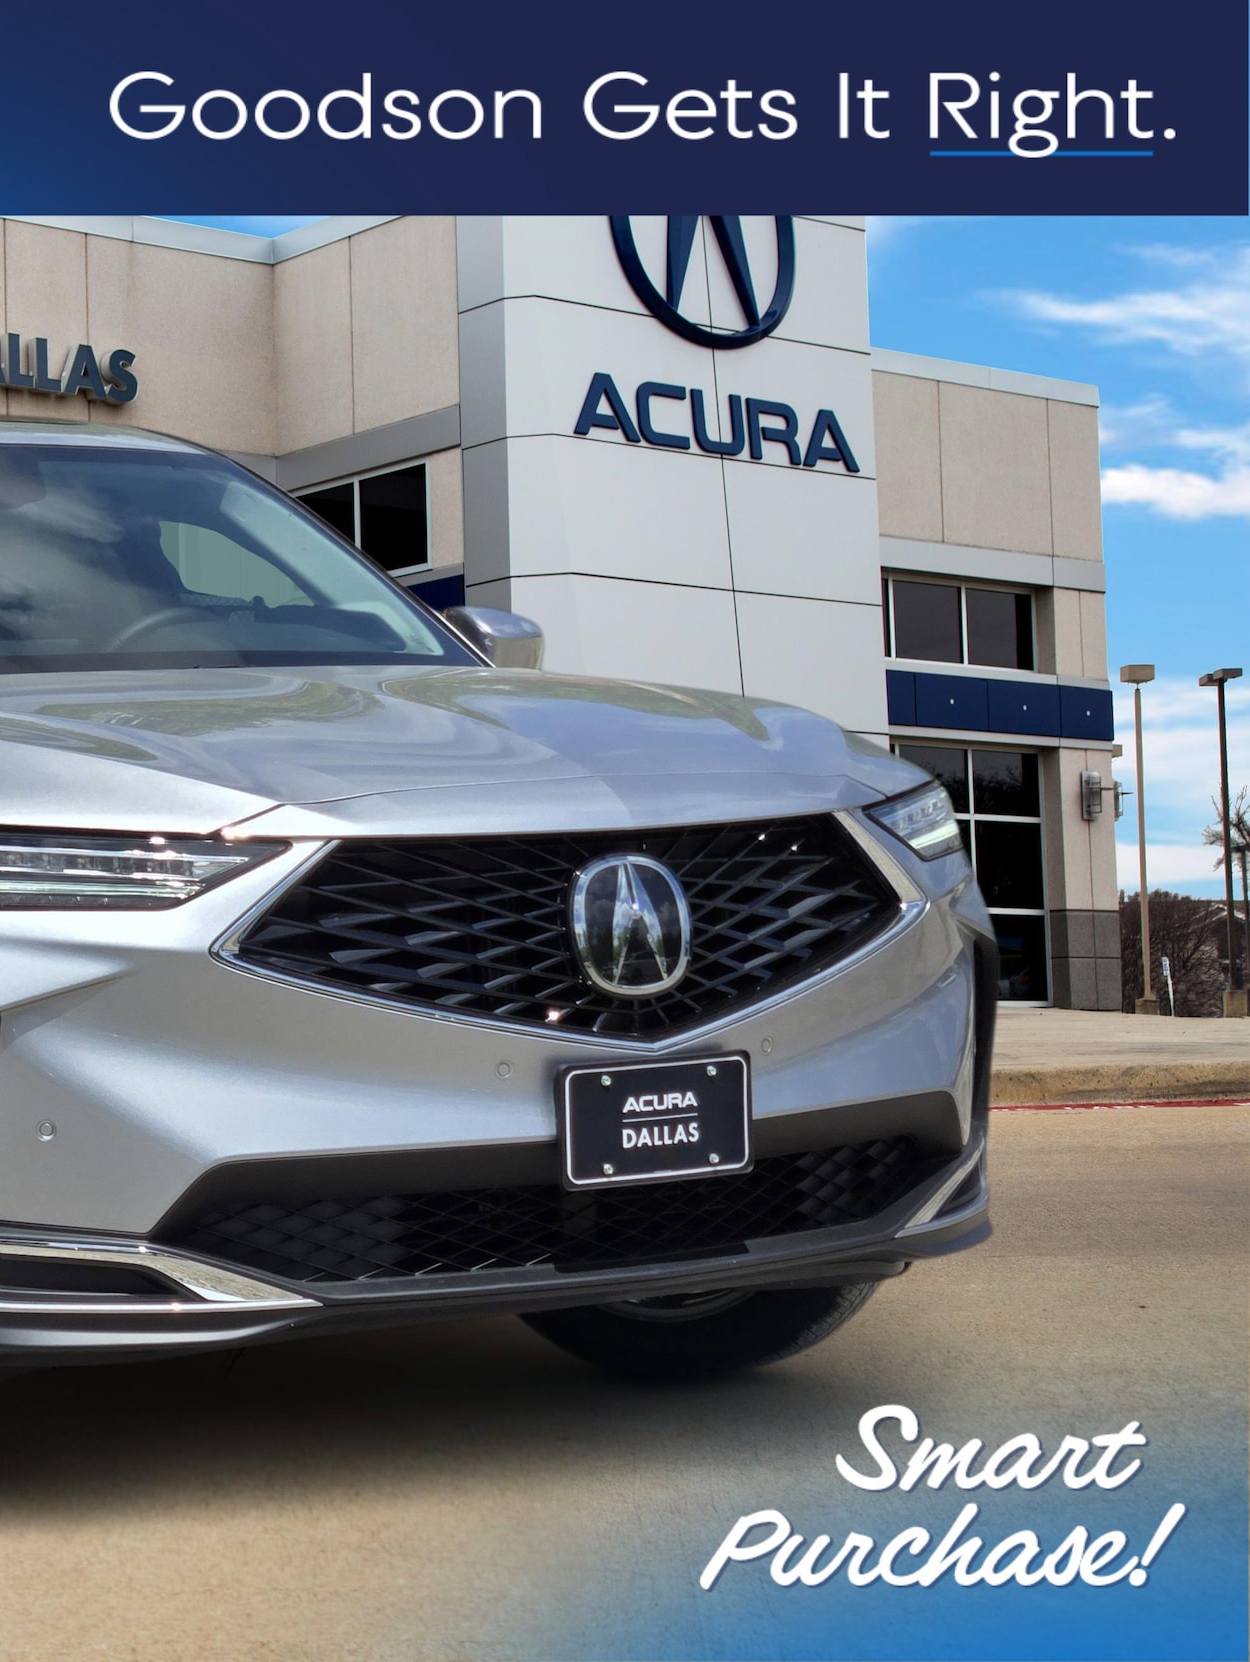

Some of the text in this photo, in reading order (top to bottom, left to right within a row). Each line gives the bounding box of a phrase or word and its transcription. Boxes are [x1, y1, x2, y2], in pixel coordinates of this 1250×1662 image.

[573, 371, 861, 473] ACURA
[622, 1091, 698, 1114] ACURA
[622, 1122, 700, 1149] DALLAS
